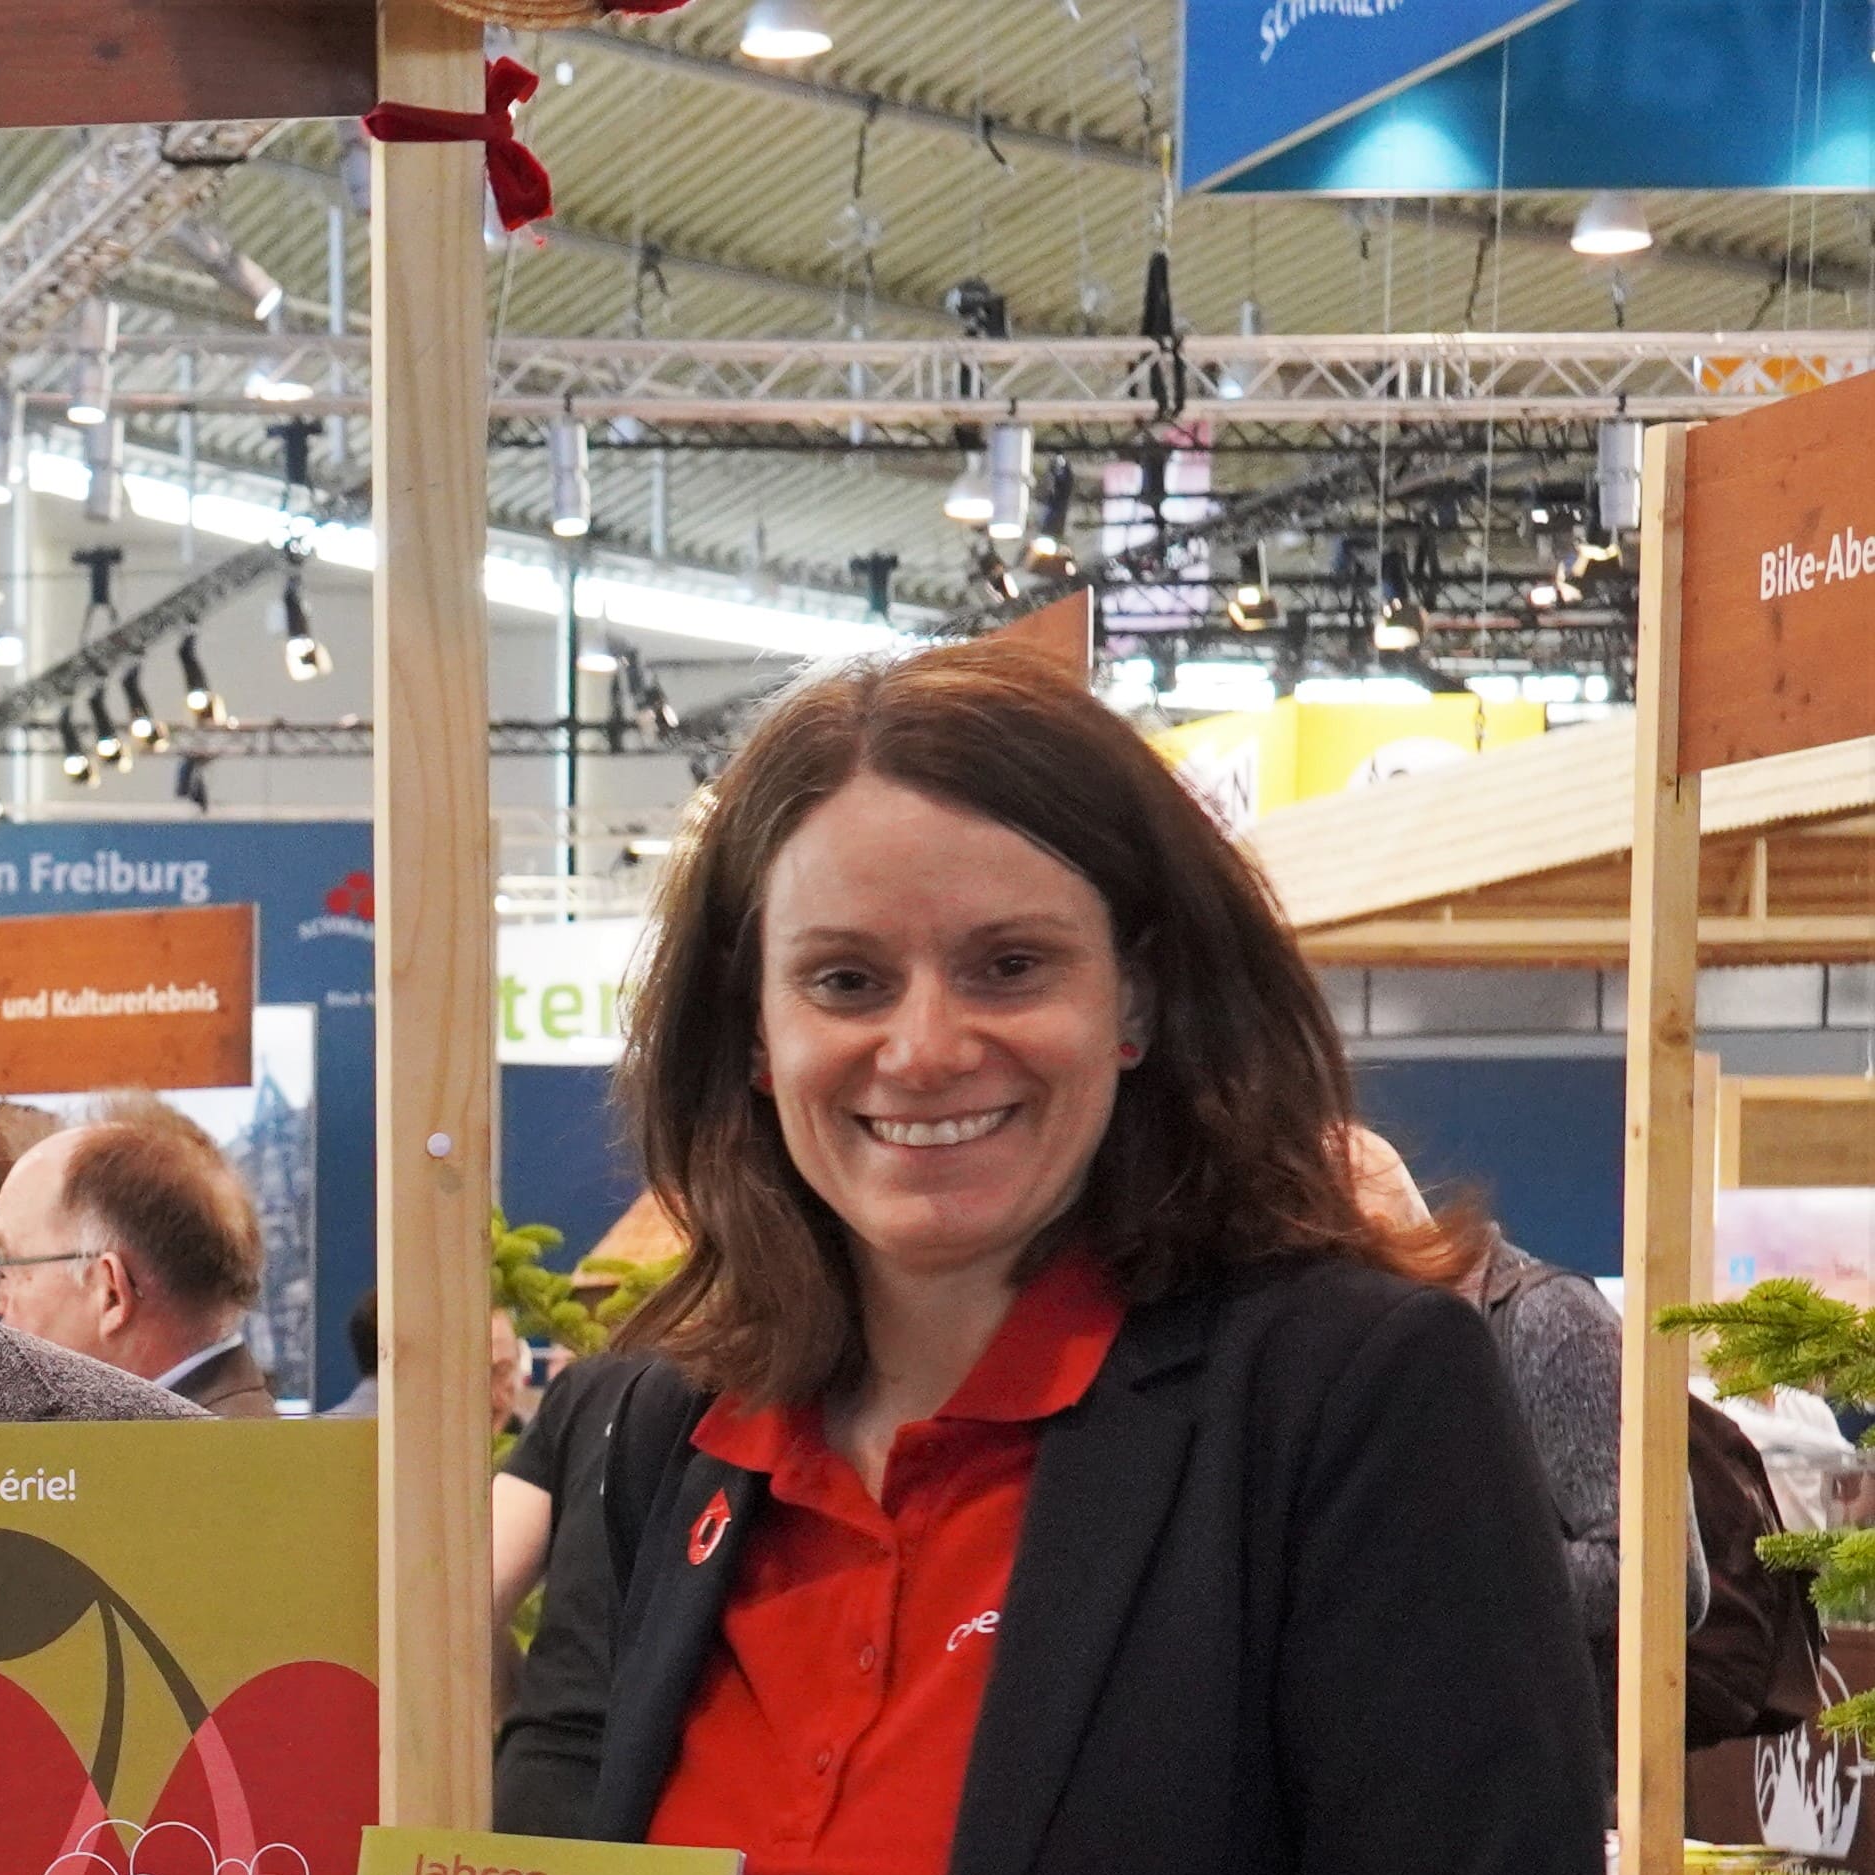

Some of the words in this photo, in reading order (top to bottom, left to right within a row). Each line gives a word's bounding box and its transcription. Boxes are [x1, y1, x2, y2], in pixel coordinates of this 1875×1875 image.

[1760, 526, 1875, 600] Bike-Abe
[30, 851, 211, 903] Freiburg
[2, 988, 47, 1019] und
[51, 981, 219, 1018] Kulturerlebnis
